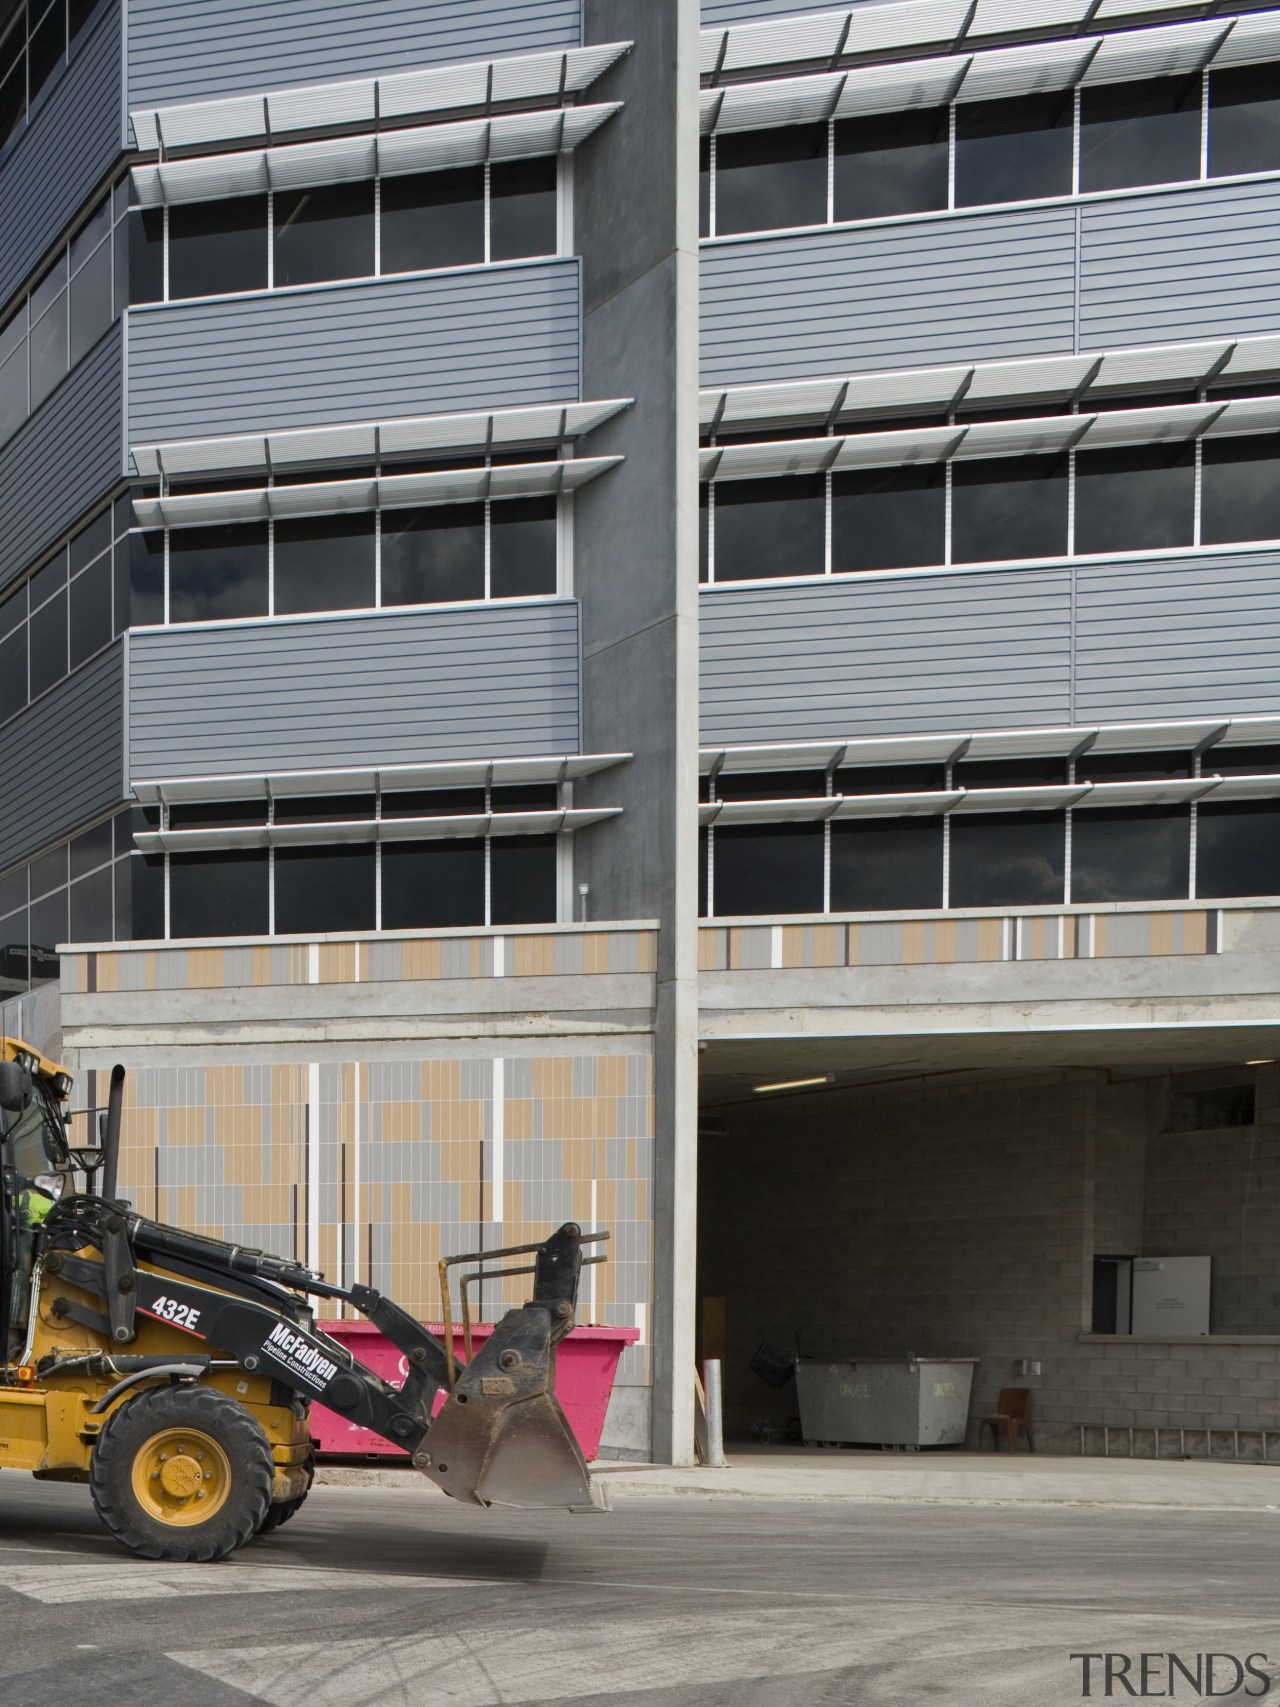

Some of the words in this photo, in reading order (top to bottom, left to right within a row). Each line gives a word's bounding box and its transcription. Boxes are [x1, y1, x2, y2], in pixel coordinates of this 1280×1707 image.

[151, 1296, 201, 1330] 432E
[263, 1340, 288, 1361] Pipeline
[286, 1356, 327, 1389] Constructions
[268, 1322, 338, 1381] McFadyen
